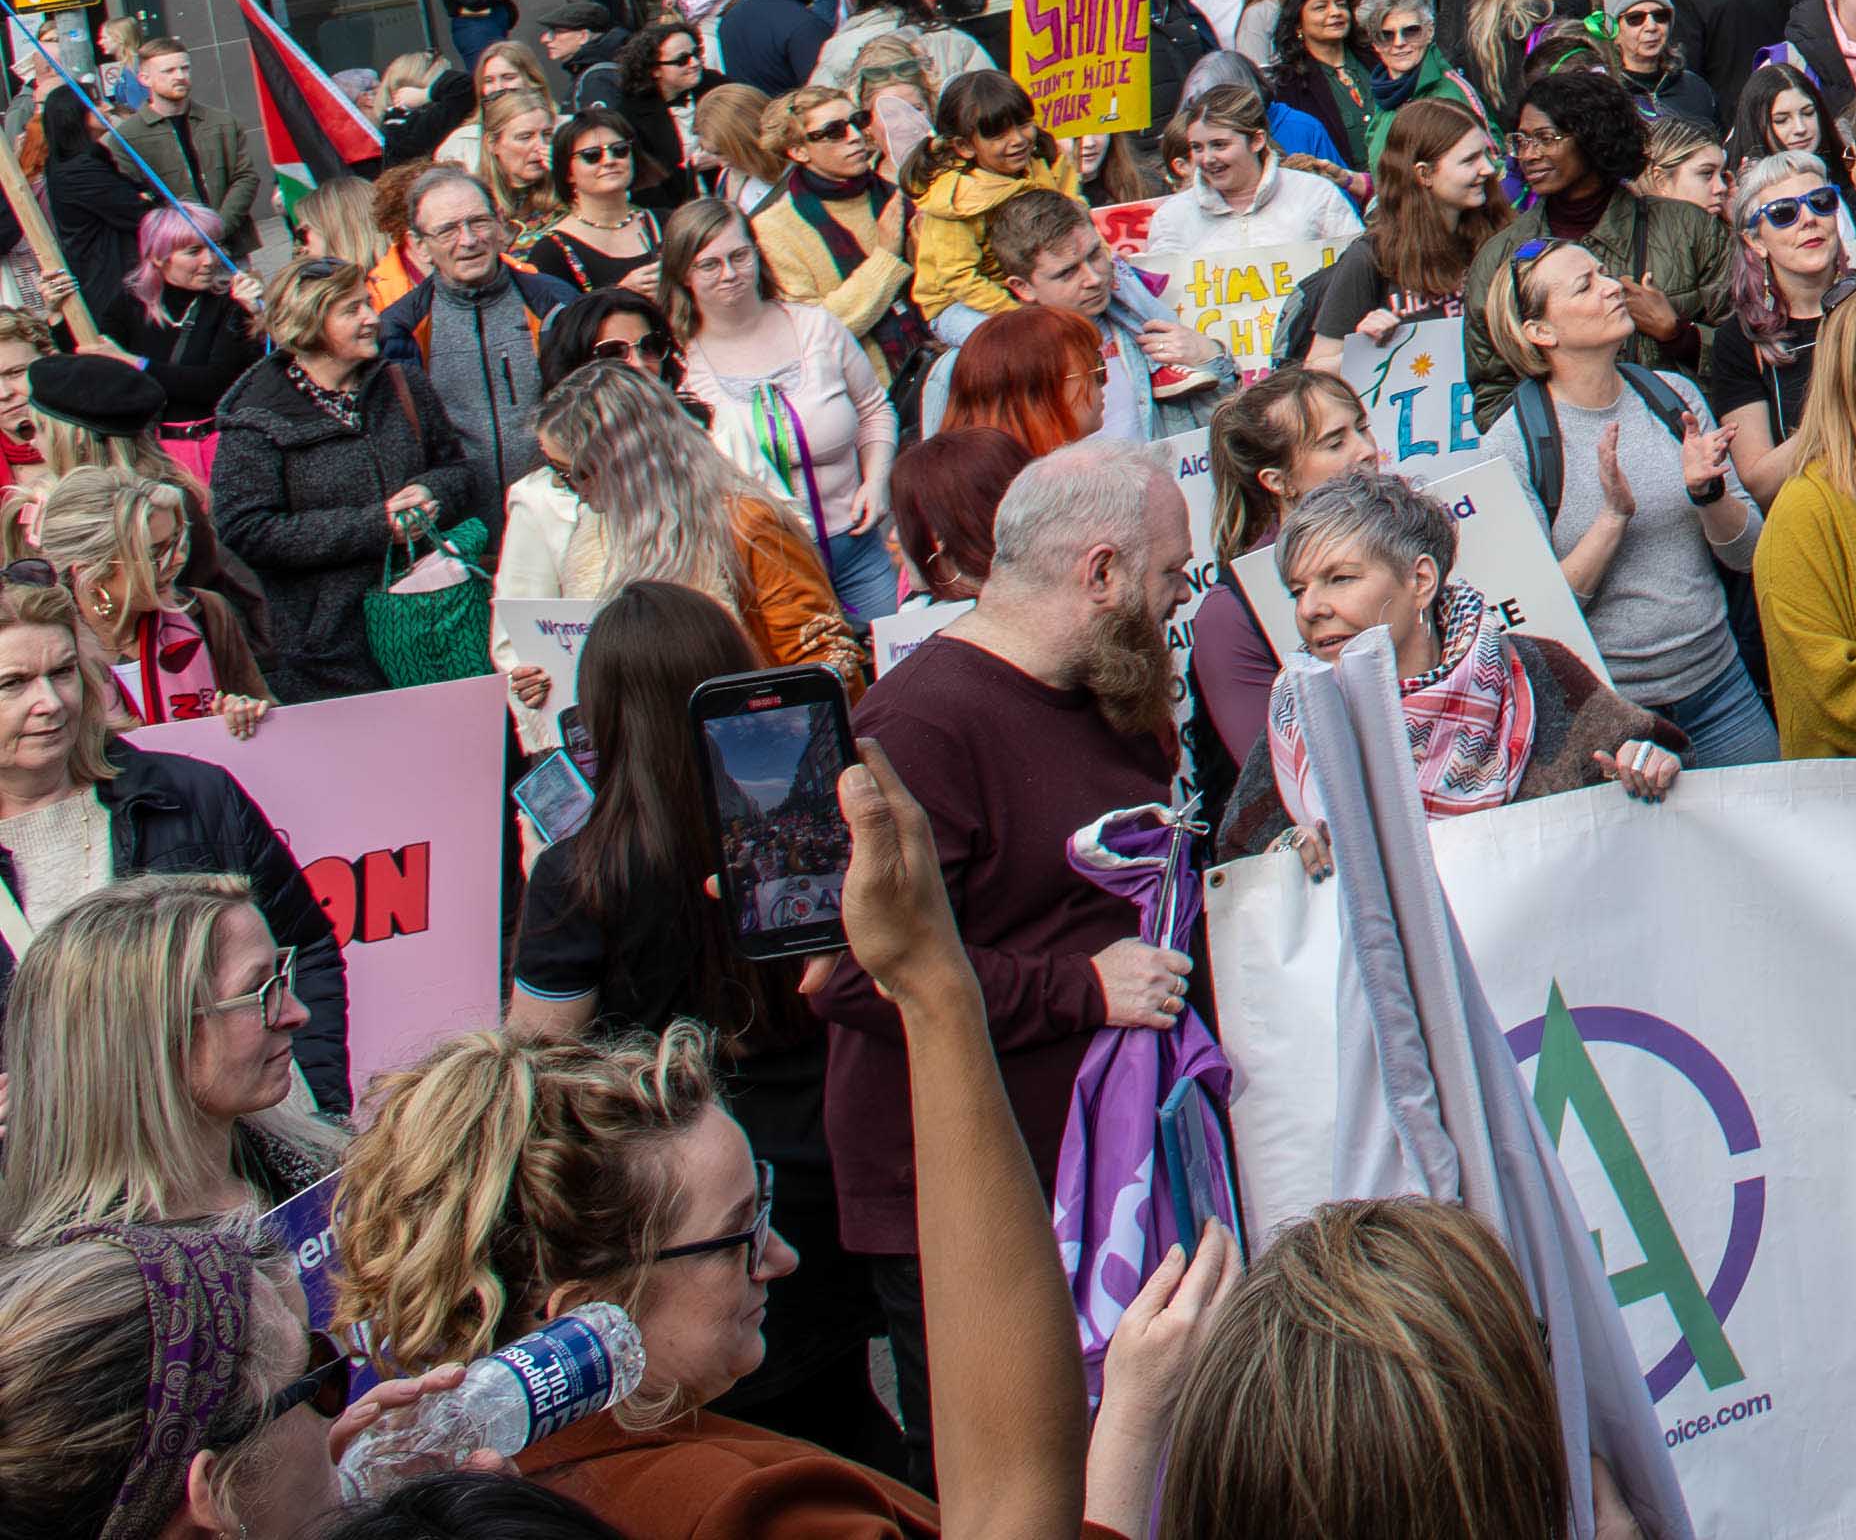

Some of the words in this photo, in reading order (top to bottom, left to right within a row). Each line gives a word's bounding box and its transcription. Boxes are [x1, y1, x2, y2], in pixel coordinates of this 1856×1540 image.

[1029, 70, 1075, 100] DON'T
[1039, 91, 1093, 129] YOUR
[1445, 493, 1477, 524] id
[301, 839, 430, 949] ON
[1664, 1390, 1773, 1449] oice.com
